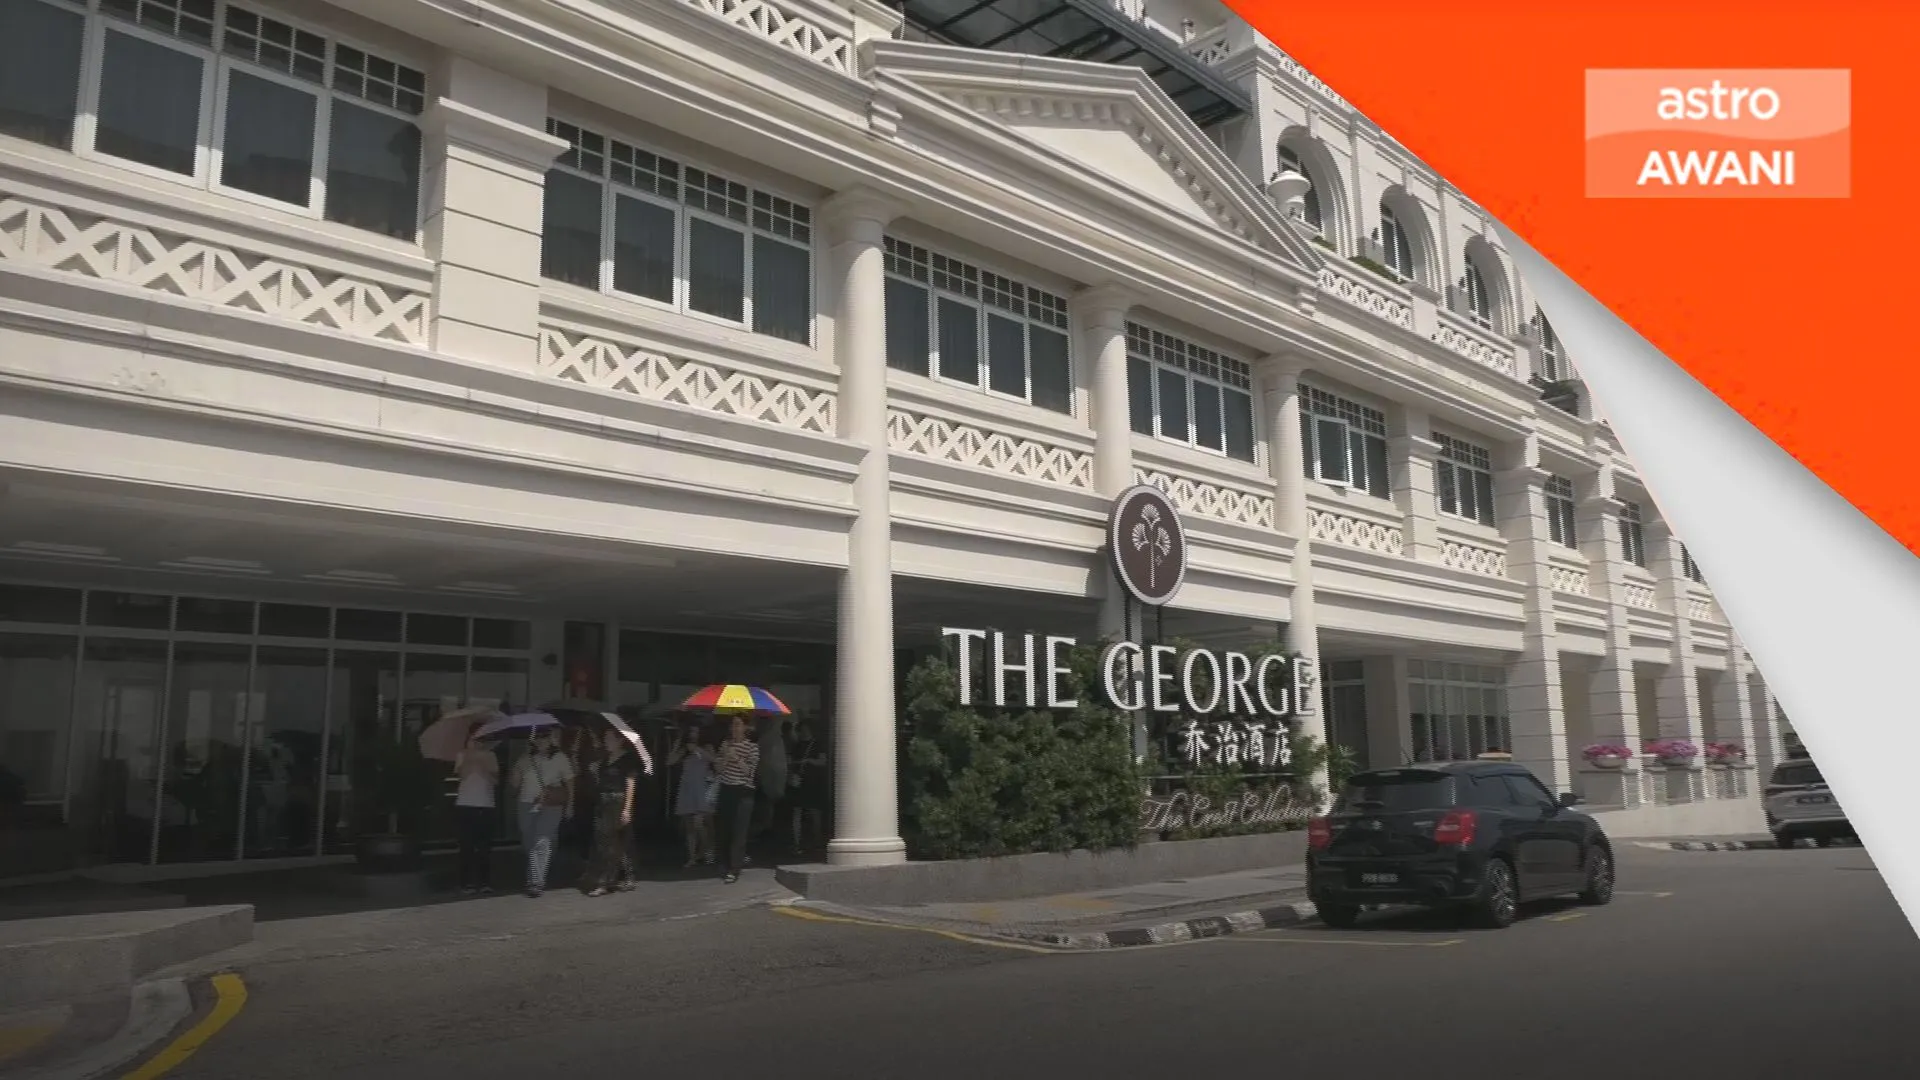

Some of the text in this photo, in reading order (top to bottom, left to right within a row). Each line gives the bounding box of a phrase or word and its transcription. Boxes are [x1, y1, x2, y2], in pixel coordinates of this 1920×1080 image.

[941, 626, 1317, 717] THE GEORGE
[1184, 720, 1292, 768] 乔治酒店
[1138, 783, 1315, 831] The Crest Collection
